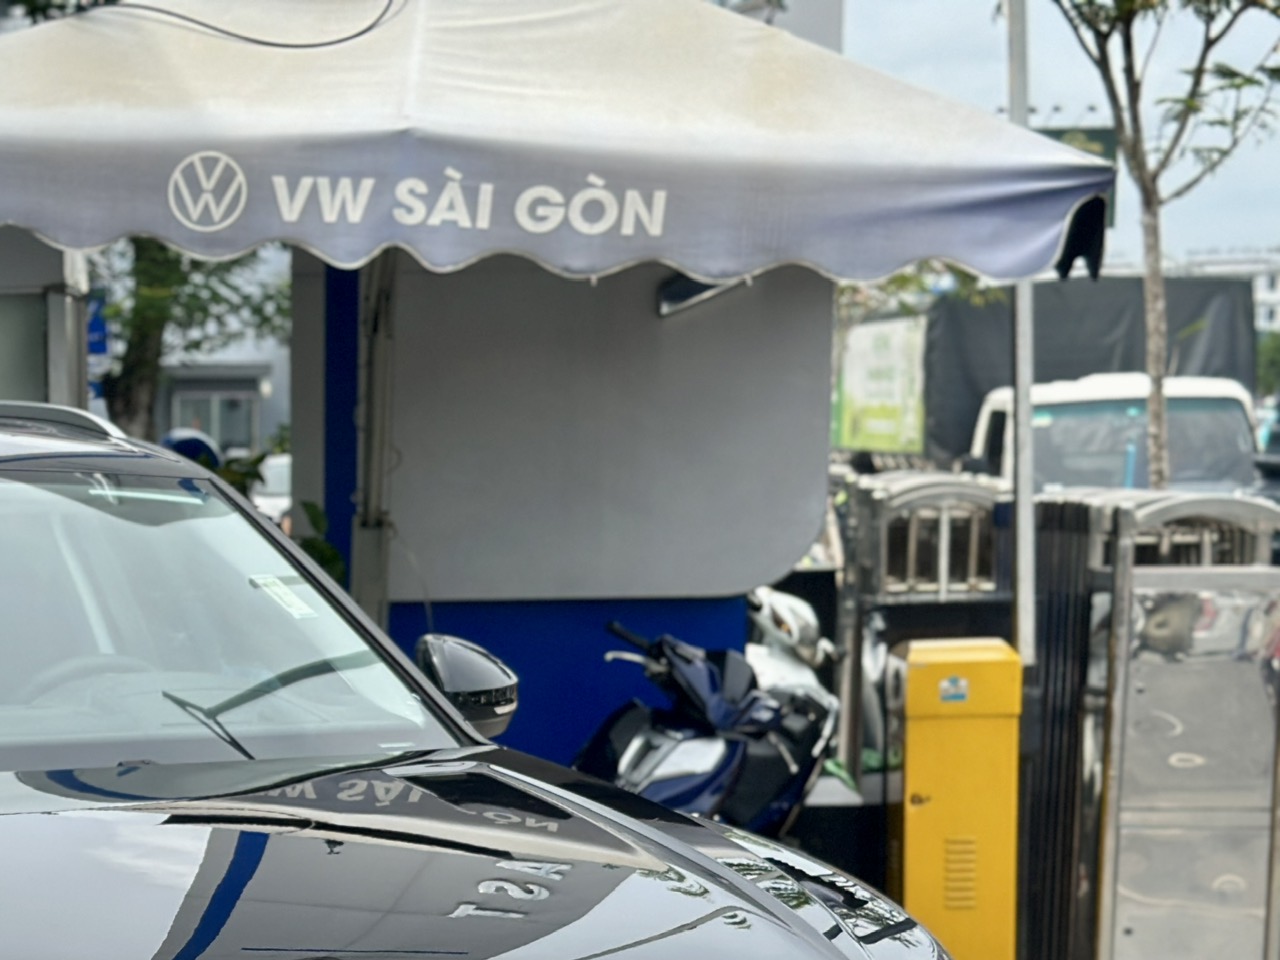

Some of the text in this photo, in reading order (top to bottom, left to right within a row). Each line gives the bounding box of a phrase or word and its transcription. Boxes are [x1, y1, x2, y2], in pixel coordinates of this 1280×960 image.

[272, 166, 667, 236] VW SÀI GÒN
